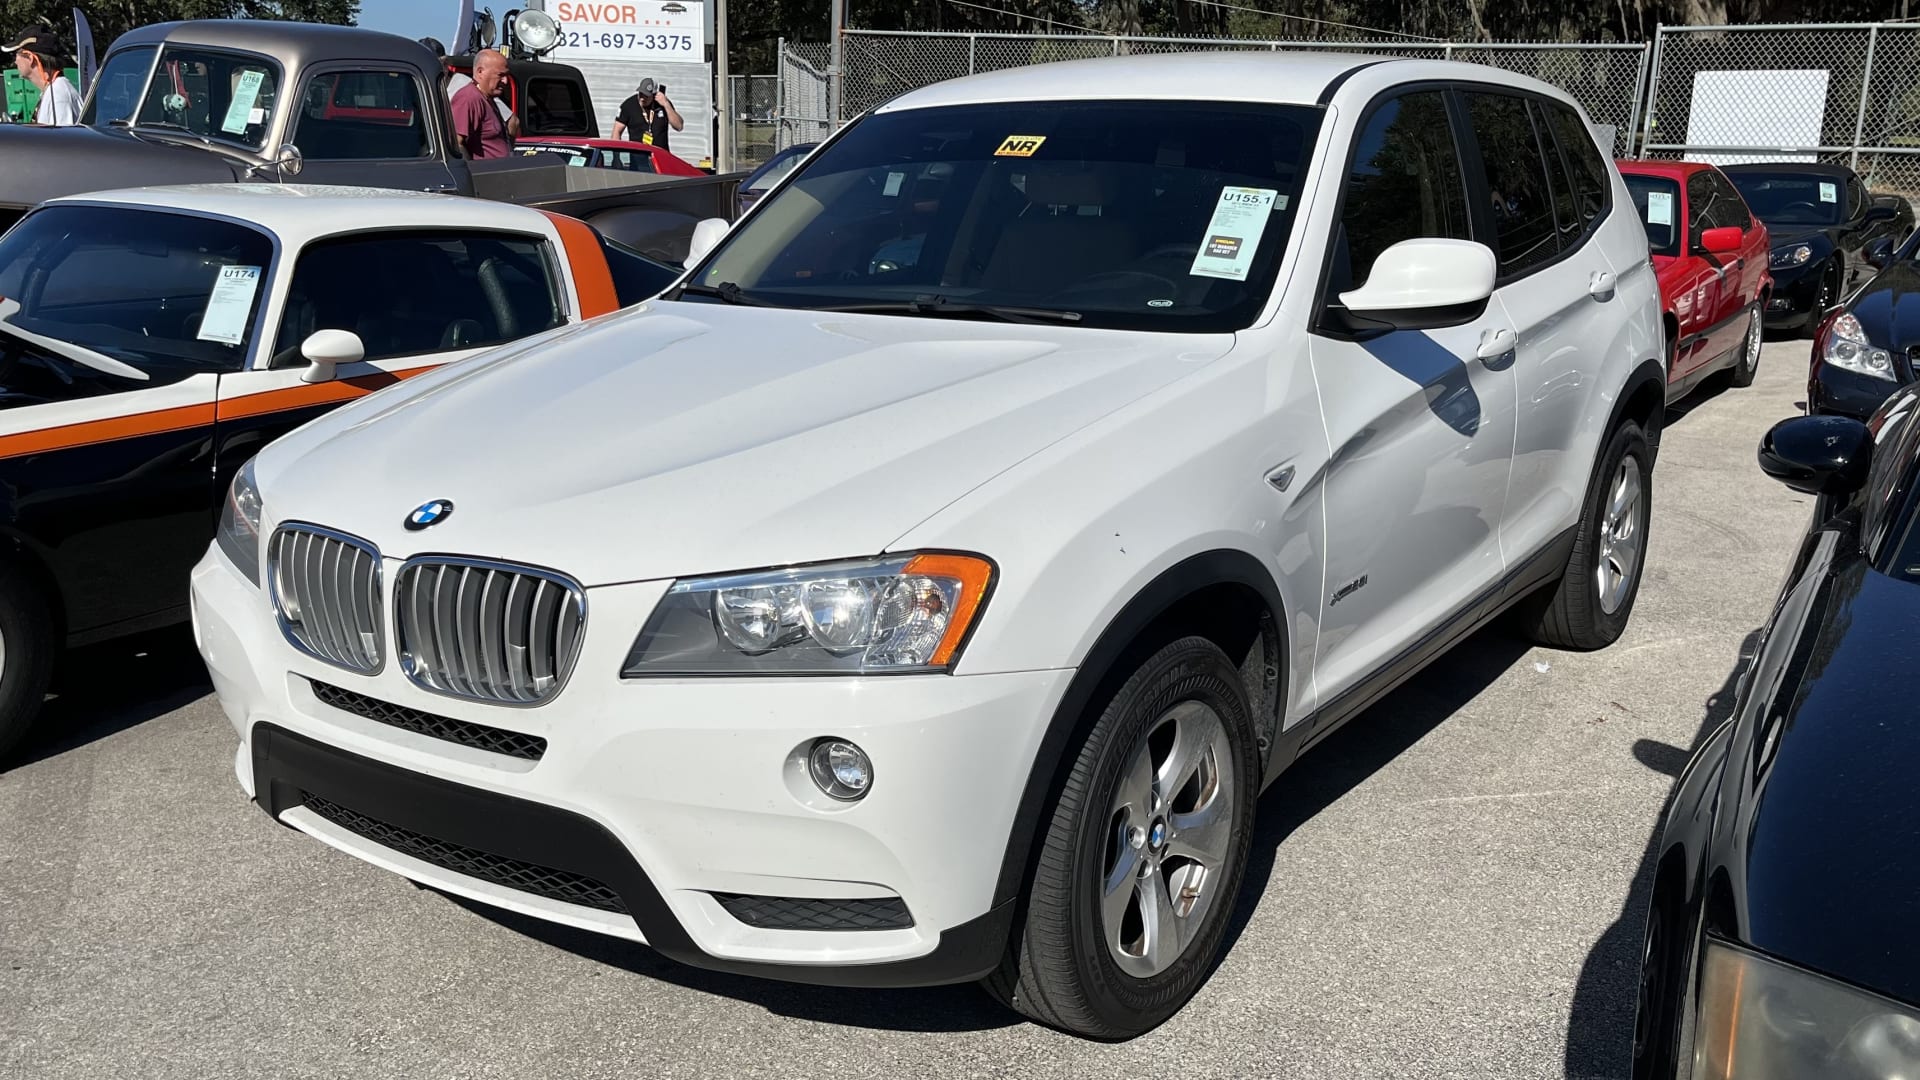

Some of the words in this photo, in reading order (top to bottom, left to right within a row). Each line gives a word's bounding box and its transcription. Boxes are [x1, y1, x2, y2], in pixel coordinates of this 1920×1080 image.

[558, 2, 637, 24] SAVOR
[1000, 140, 1037, 152] NR
[1223, 193, 1271, 204] U155.1
[224, 270, 255, 278] U174
